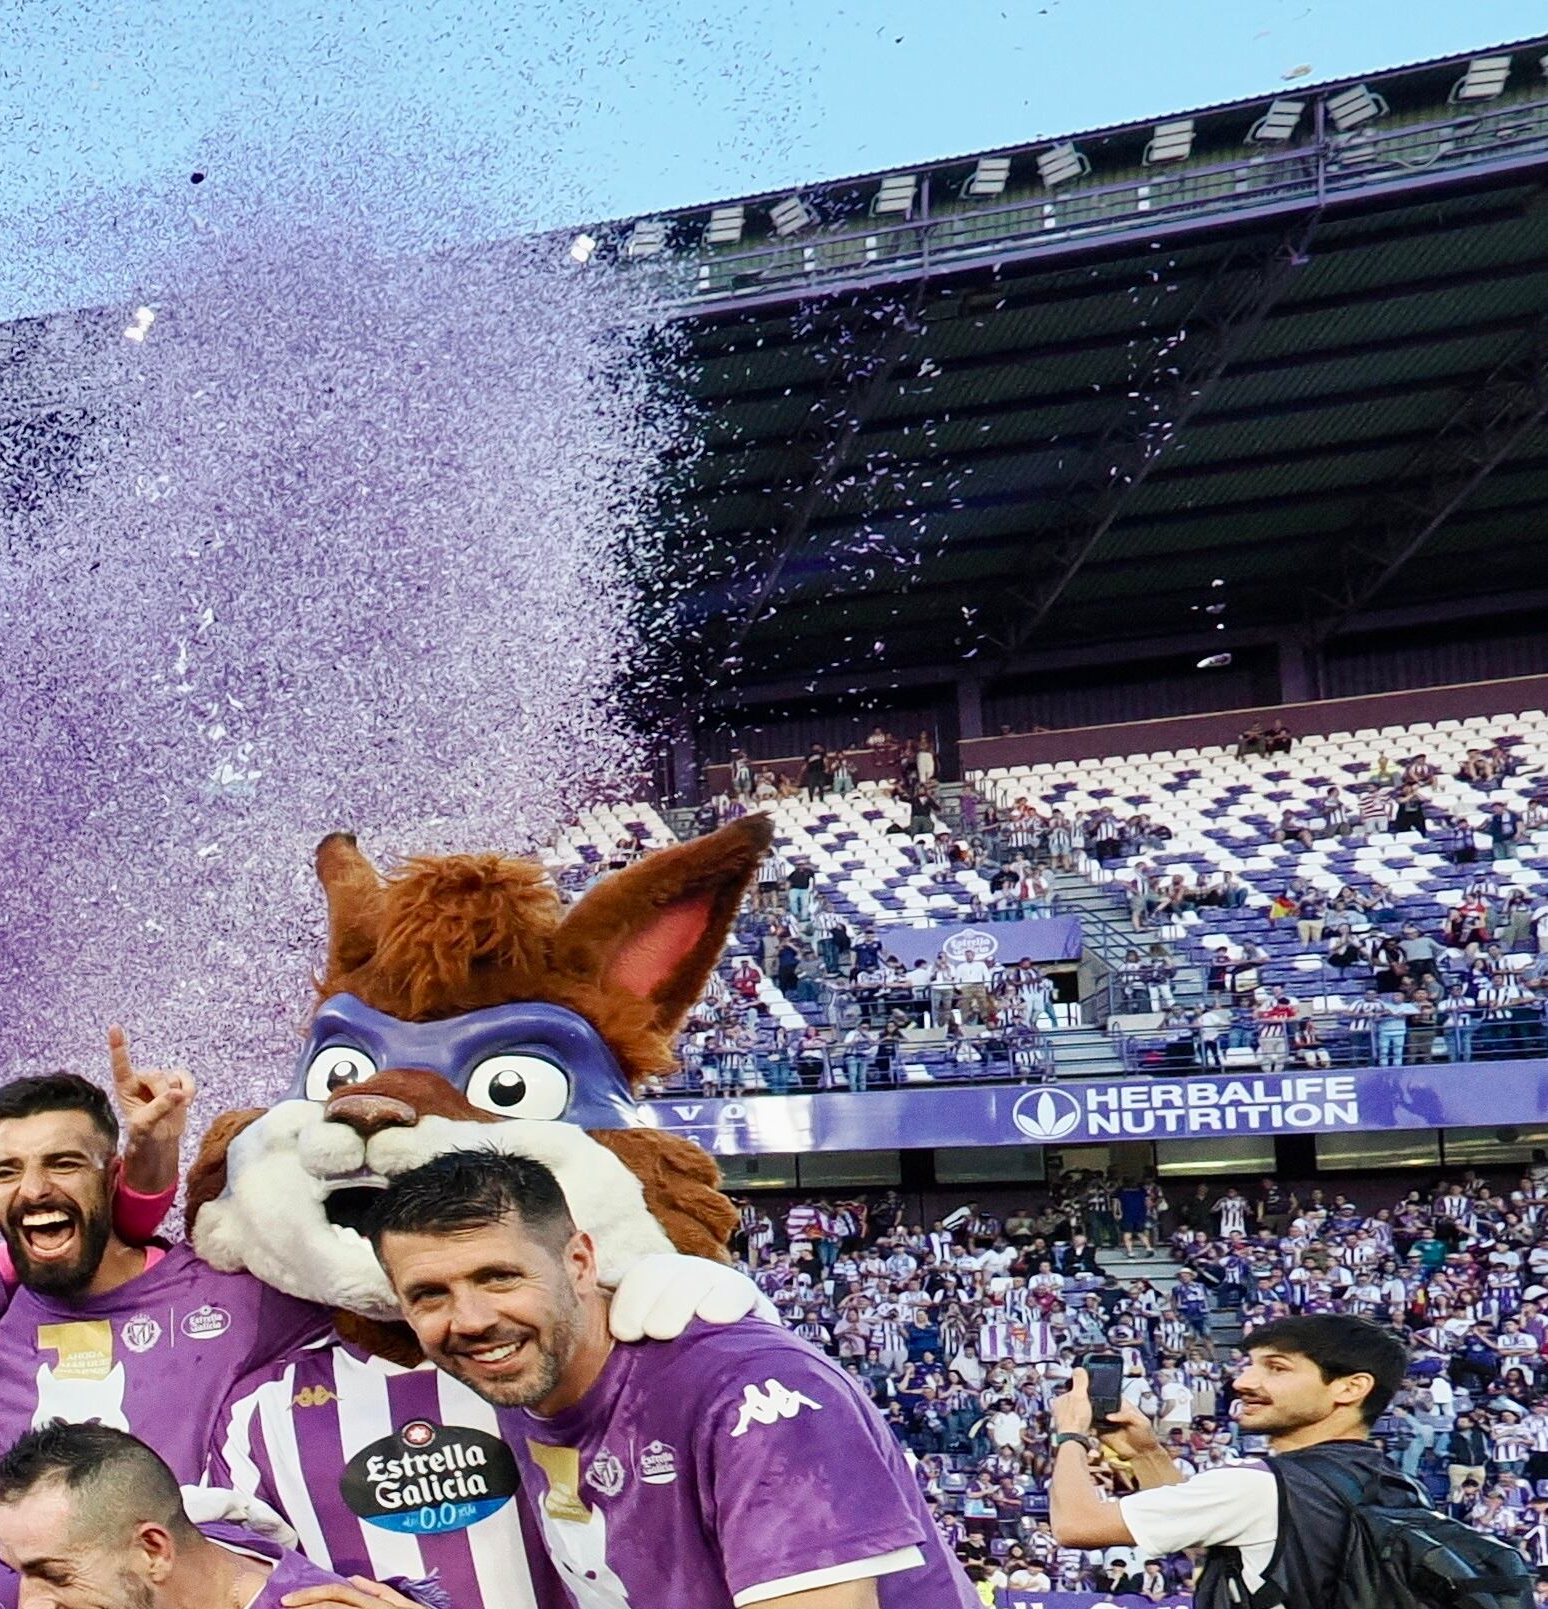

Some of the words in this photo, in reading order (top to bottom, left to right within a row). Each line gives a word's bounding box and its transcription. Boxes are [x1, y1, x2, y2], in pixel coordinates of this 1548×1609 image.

[1087, 1077, 1357, 1112] HERBALIFE
[1087, 1102, 1359, 1135] NUTRITION
[366, 1444, 488, 1483] Estrella
[375, 1474, 489, 1510] Galicia
